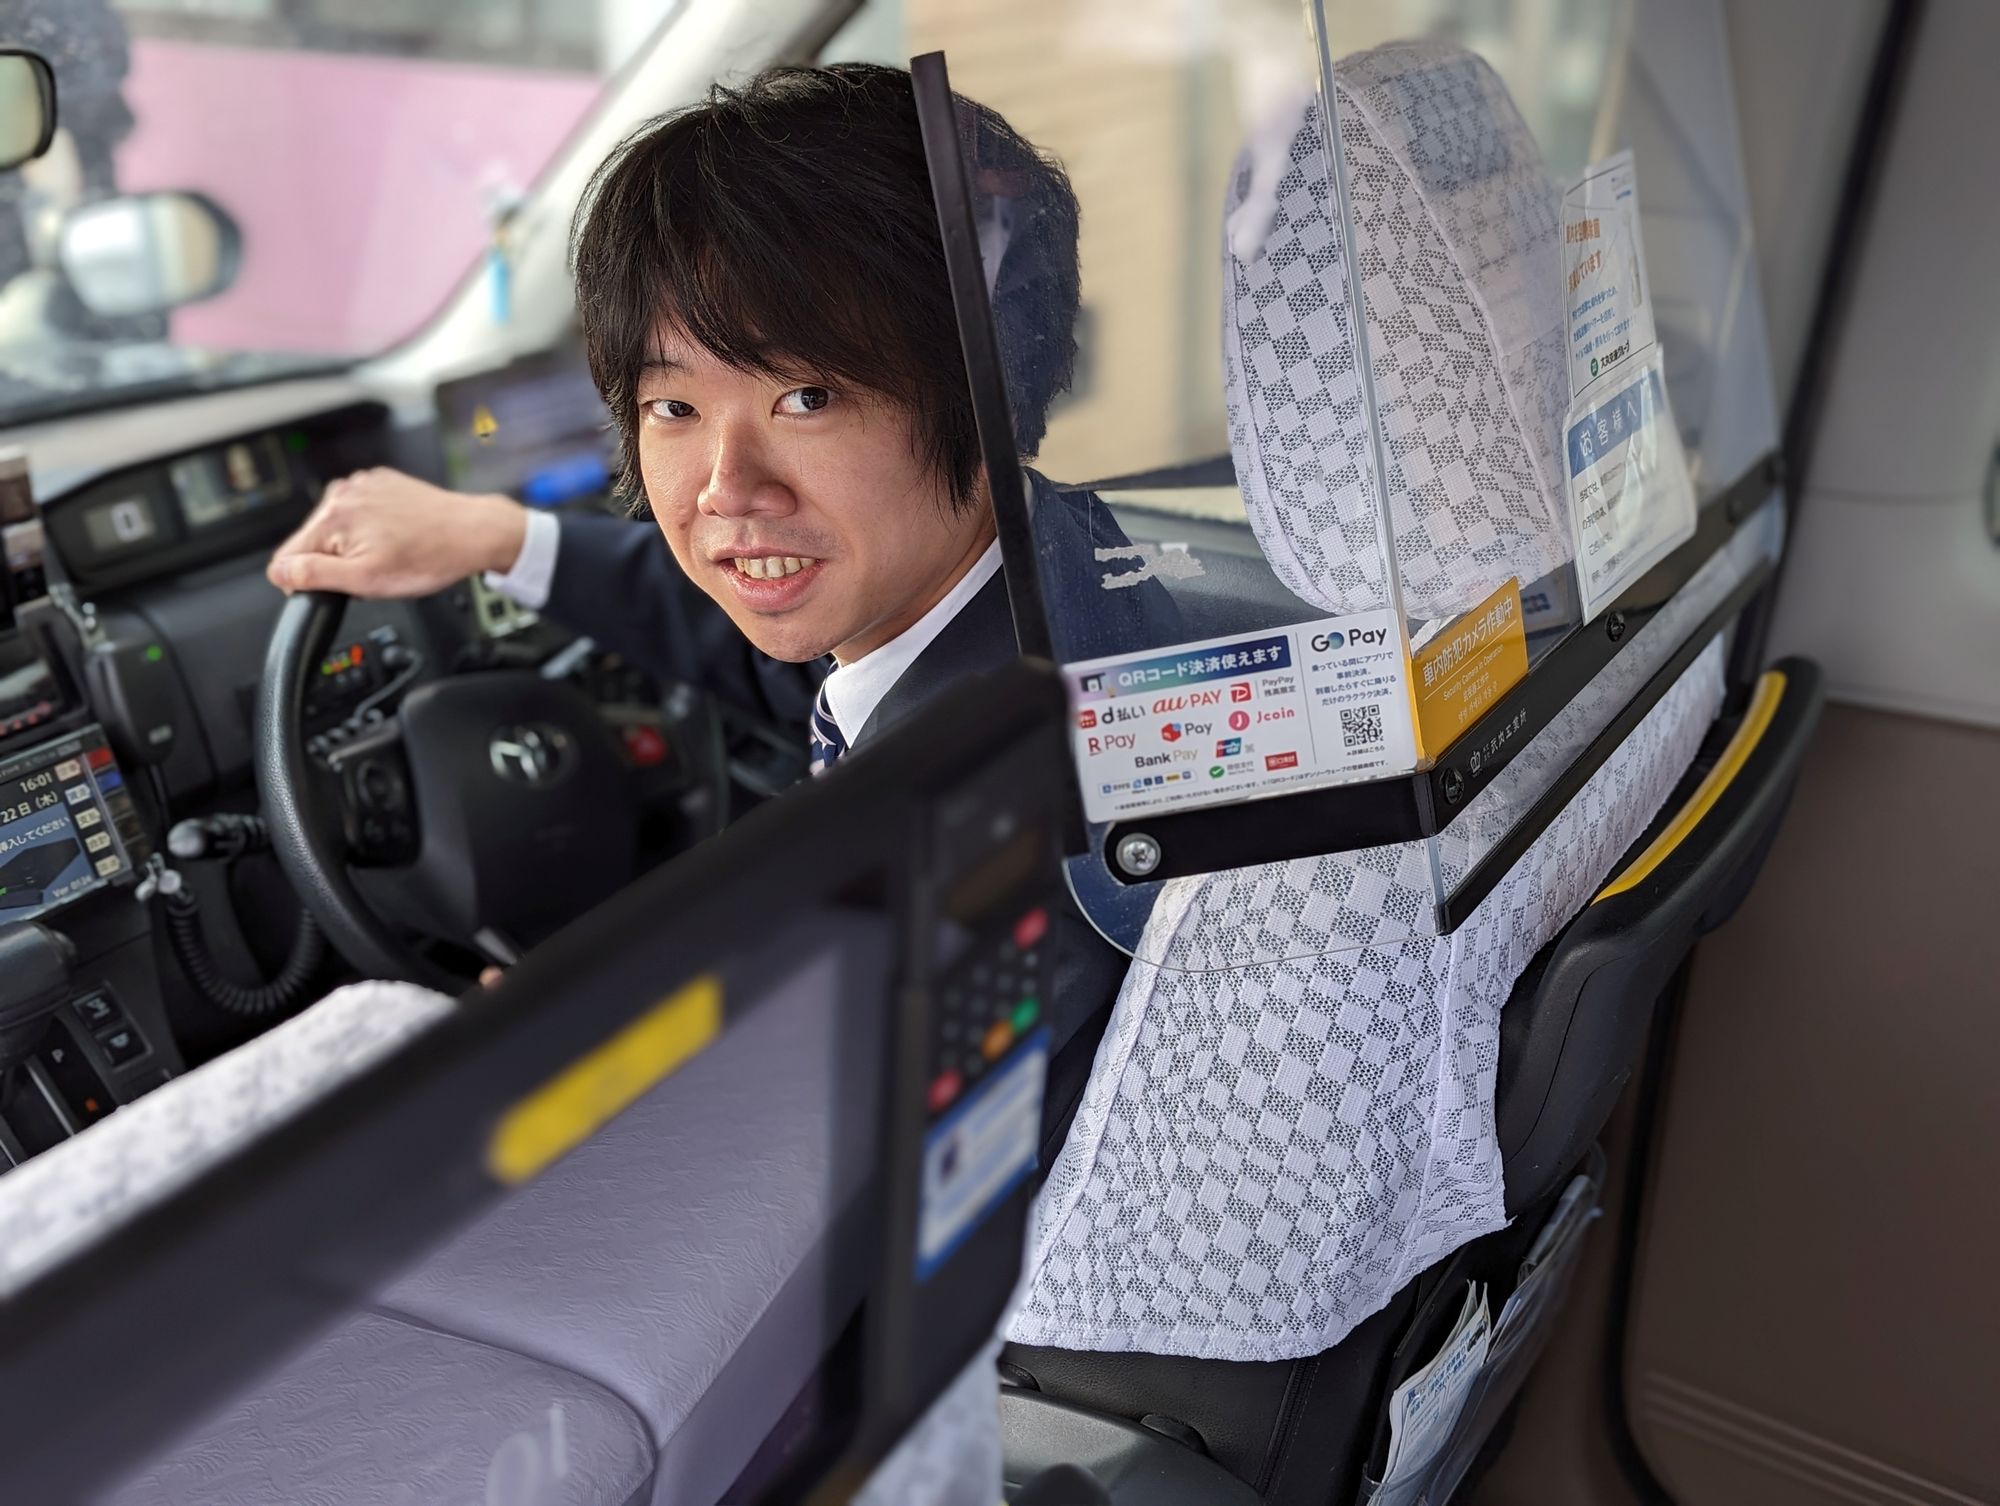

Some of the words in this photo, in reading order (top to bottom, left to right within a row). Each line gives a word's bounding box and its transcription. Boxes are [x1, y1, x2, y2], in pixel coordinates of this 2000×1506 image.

[1579, 401, 1637, 457] お客様へ
[1349, 627, 1388, 647] Pay
[1423, 596, 1514, 688] 車内防犯カメラ作動中
[1118, 645, 1282, 687] QRコード決済使えます
[1311, 651, 1394, 673] 乗っている間にアプリで
[1262, 676, 1295, 687] PayPay
[1315, 674, 1397, 696] 到着したらすぐに降りる
[1152, 694, 1188, 715] au
[1190, 689, 1222, 708] PAY
[1101, 705, 1147, 725] d払い
[1185, 723, 1213, 737] Pay
[1104, 733, 1136, 750] Pay
[1134, 753, 1172, 769] Bank
[1173, 749, 1199, 763] Pay
[20, 772, 53, 793] 16:01
